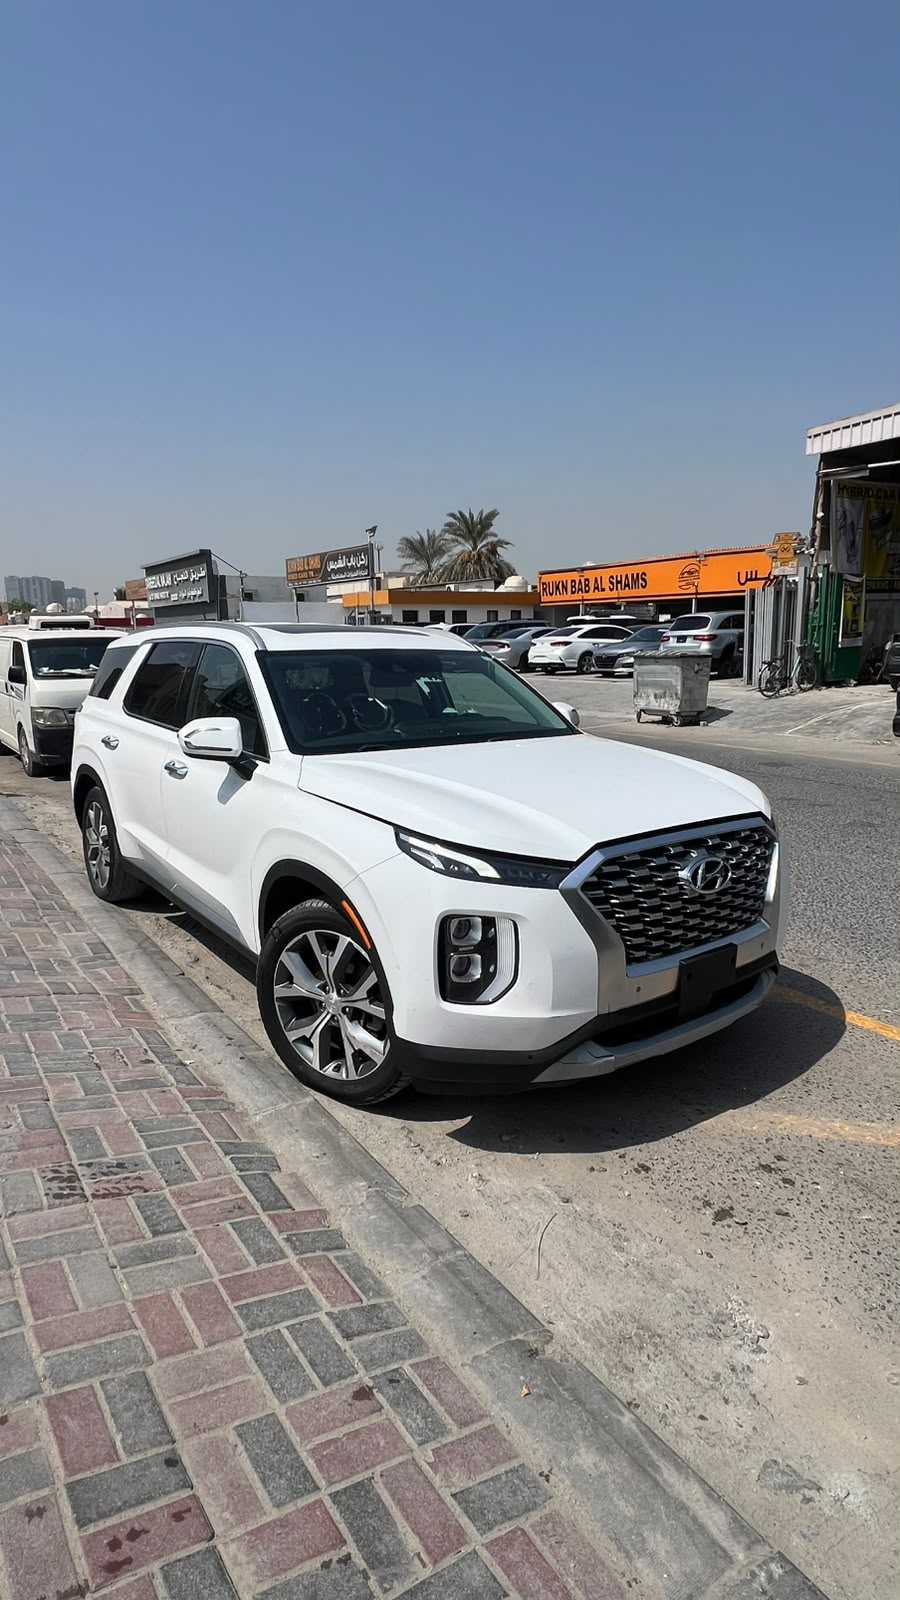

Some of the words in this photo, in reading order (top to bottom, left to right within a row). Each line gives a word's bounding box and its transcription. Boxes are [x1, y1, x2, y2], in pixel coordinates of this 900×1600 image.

[541, 580, 568, 597] RUKN
[570, 578, 590, 595] BAB
[592, 576, 606, 593] AL
[608, 571, 648, 592] SHAMS
